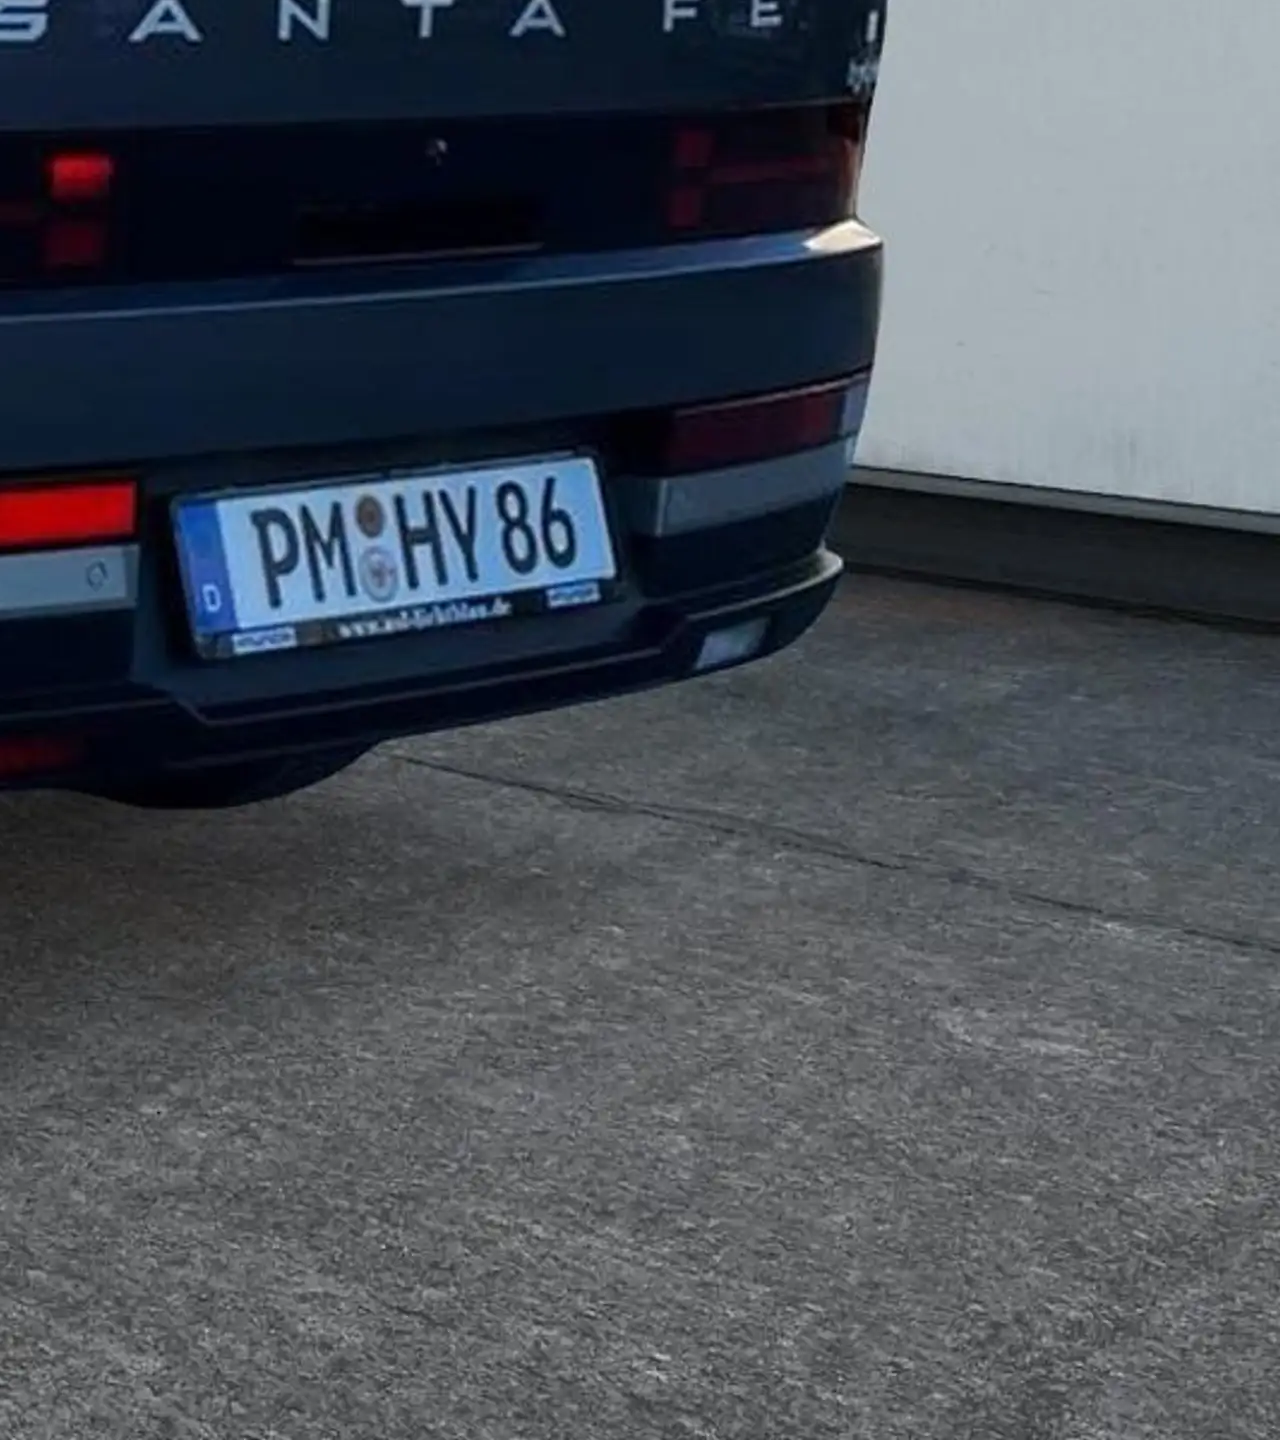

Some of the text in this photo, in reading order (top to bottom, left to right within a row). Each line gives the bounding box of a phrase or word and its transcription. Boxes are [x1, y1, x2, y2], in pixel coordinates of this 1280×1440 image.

[250, 476, 576, 609] PM HY 86
[202, 583, 221, 612] D
